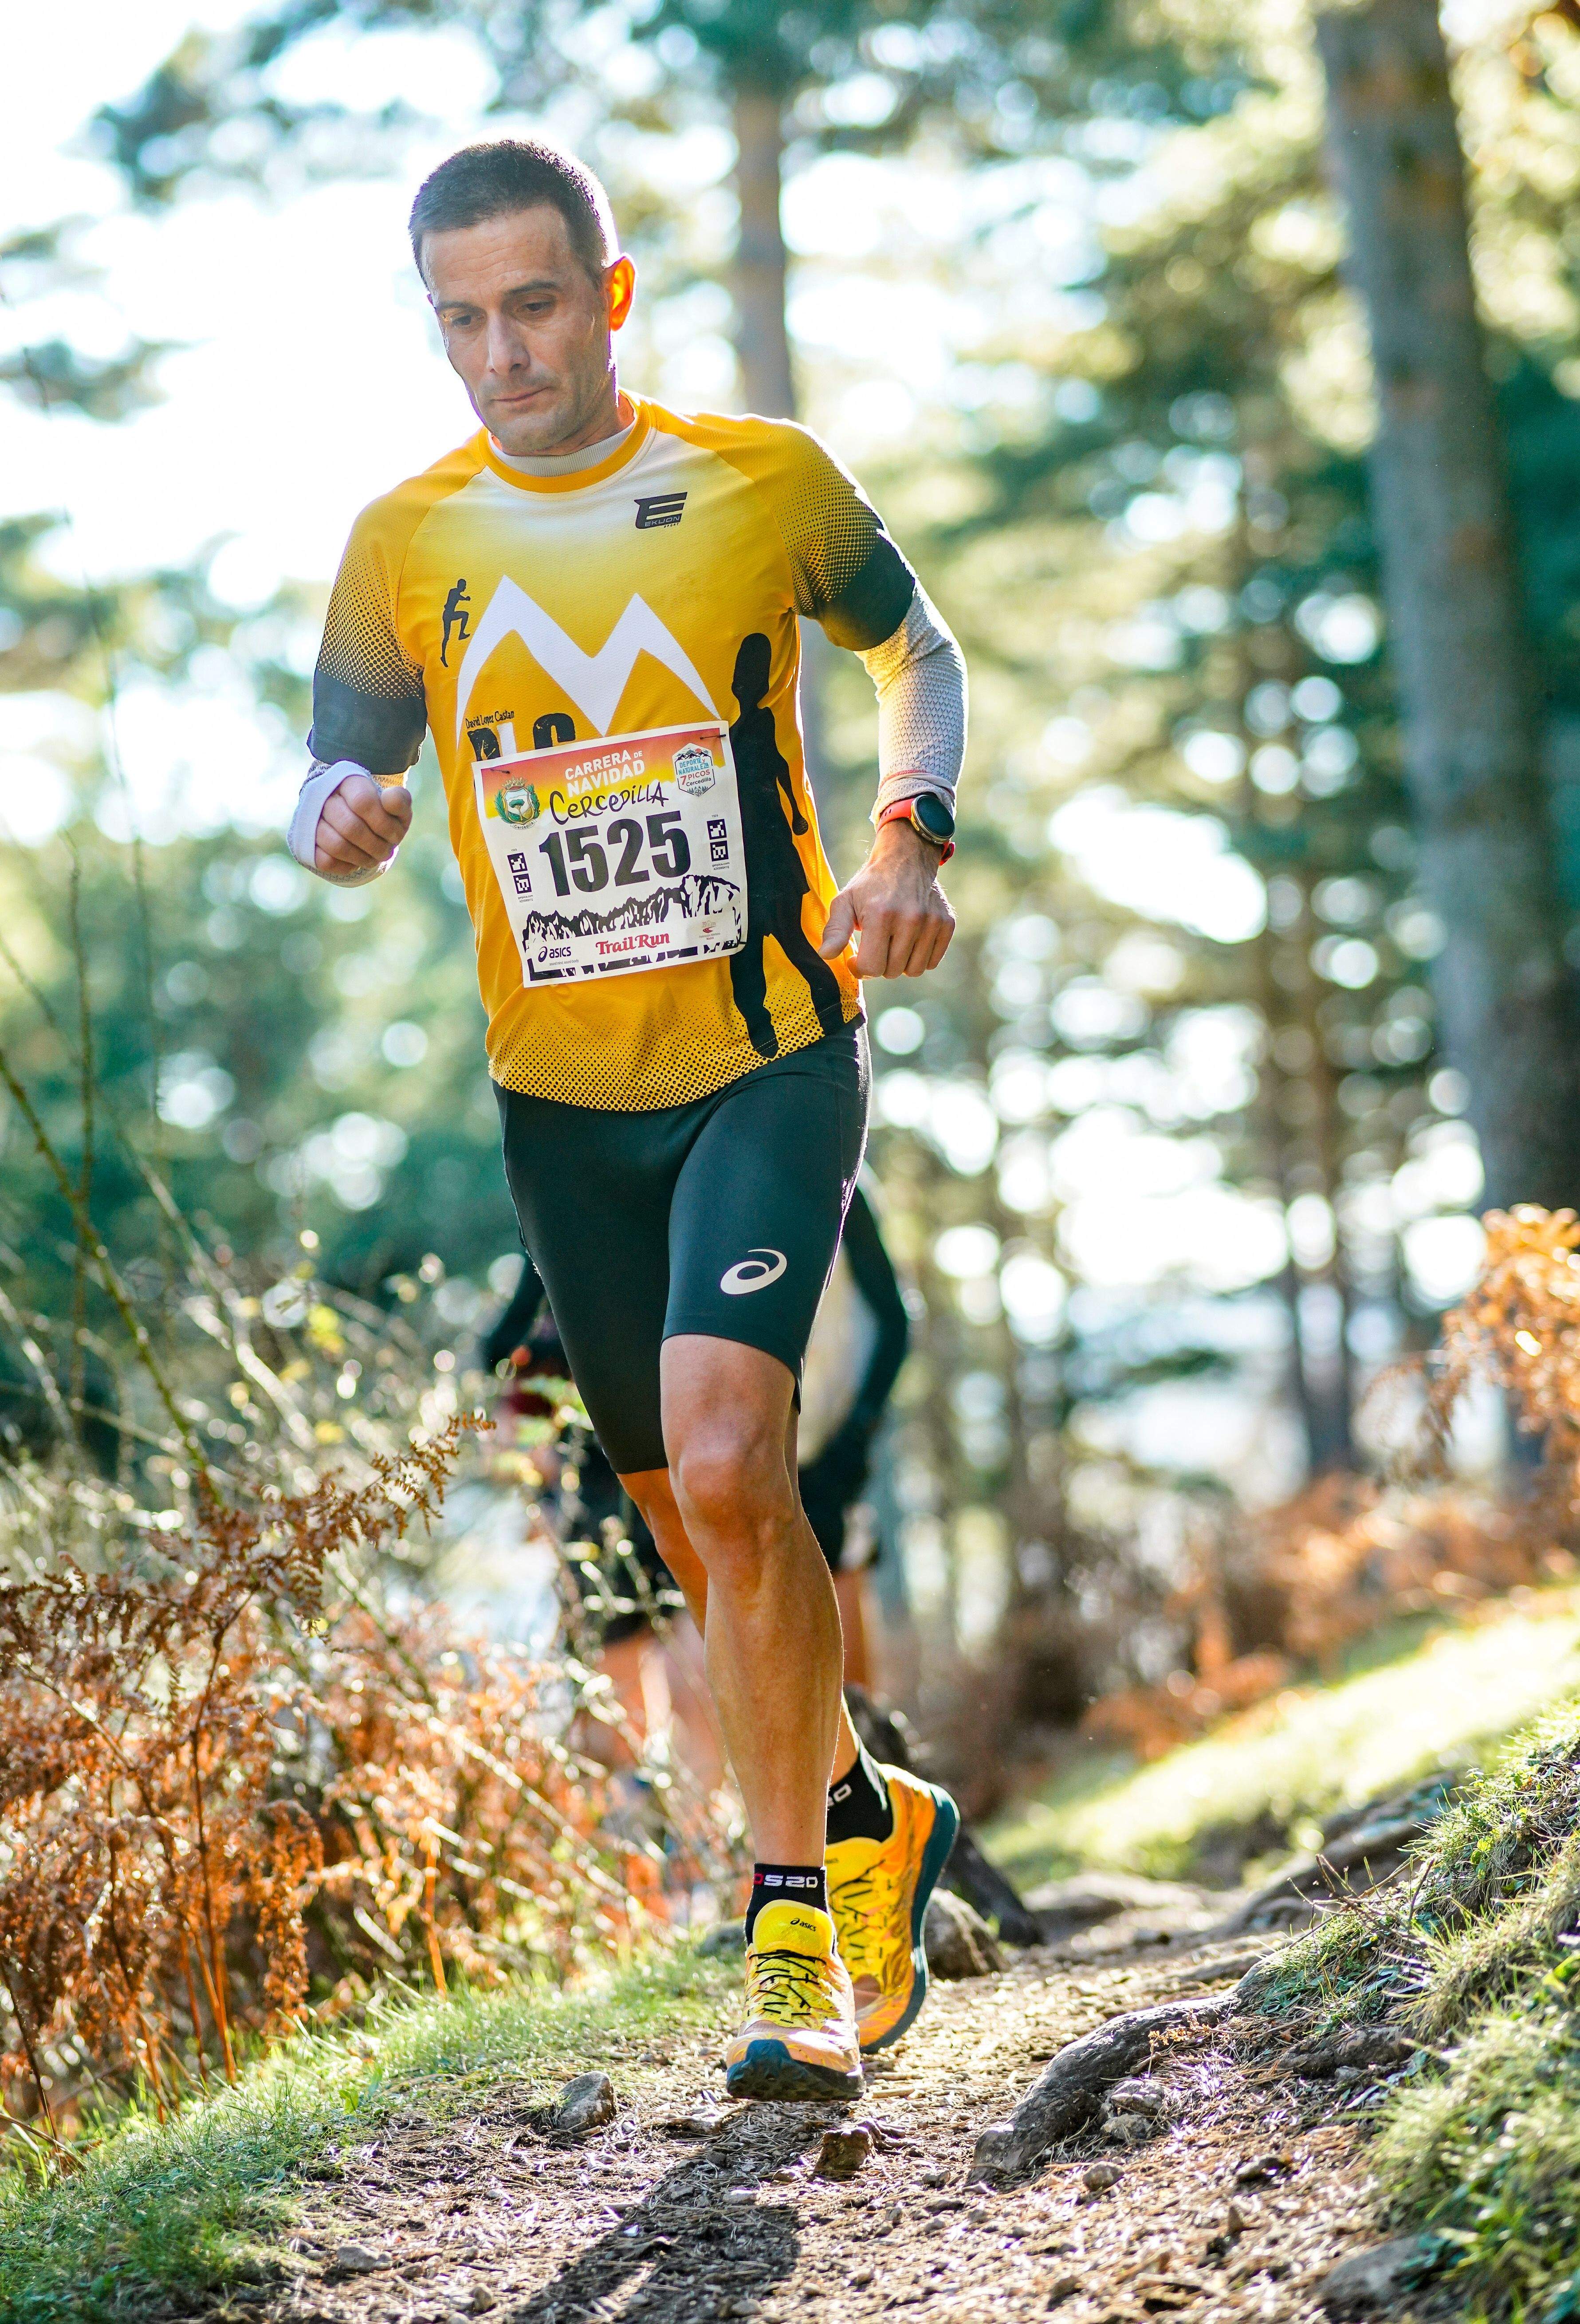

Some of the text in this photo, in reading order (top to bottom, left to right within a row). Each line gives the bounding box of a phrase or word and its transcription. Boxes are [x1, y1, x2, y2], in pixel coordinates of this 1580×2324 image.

[465, 709, 515, 729] David Lopez Castan
[565, 749, 632, 780] CARRERA
[678, 762, 709, 775] NATURALEZA
[680, 758, 701, 768] DEPORTE
[567, 759, 645, 798] NAVIDAD
[680, 769, 710, 785] 7 PICOS
[686, 777, 711, 786] Cercedilla
[539, 810, 691, 897] 1525
[595, 933, 670, 955] Trail Run
[549, 946, 571, 959] asics
[799, 1921, 817, 1932] asics
